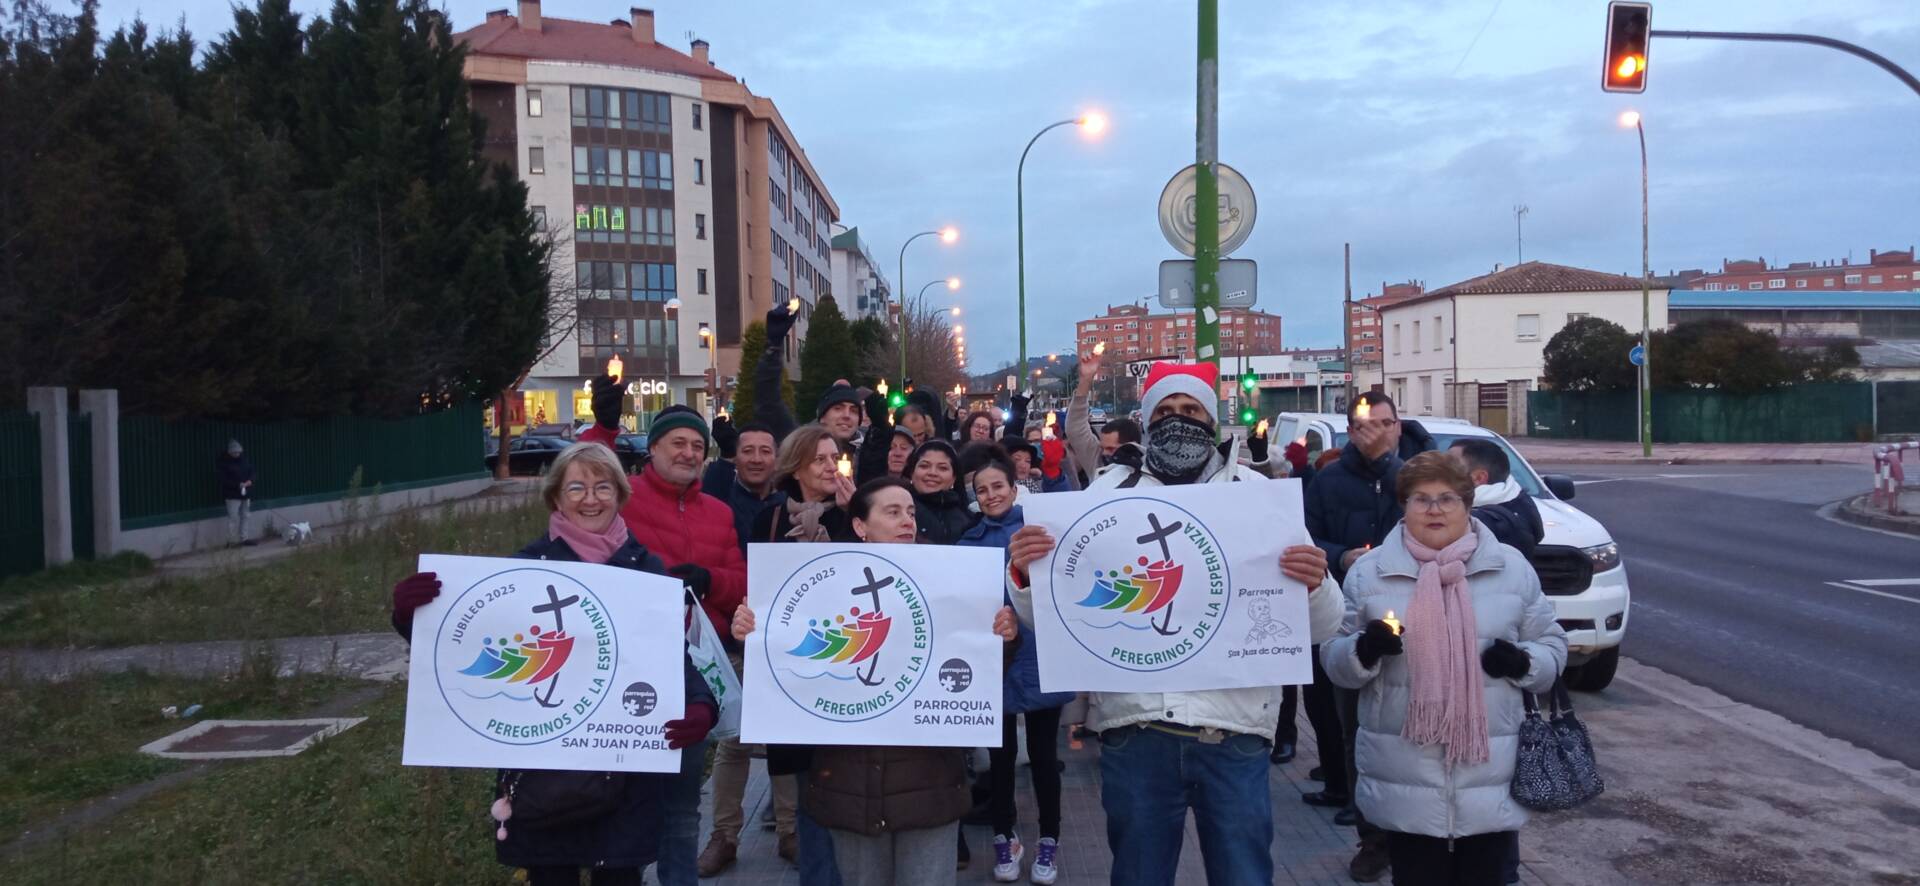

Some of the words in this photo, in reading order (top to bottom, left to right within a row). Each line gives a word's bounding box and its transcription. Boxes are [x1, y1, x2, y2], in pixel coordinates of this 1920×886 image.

[1065, 534, 1091, 578] JUBILEO
[1089, 515, 1118, 538] 2025
[1183, 522, 1223, 595] ESPERANZA
[781, 583, 810, 627] JUBILEO
[809, 567, 836, 586] 2025
[1238, 587, 1284, 598] Parroquia
[451, 599, 486, 645] JUBILEO
[485, 583, 516, 602] 2025
[894, 577, 927, 649] ESPERANZA
[1205, 602, 1221, 618] LA
[578, 596, 611, 671] ESPERANZA
[1192, 622, 1211, 640] DE
[1111, 638, 1194, 665] PEREGRINOS
[1258, 647, 1270, 655] de
[908, 656, 923, 673] LA
[588, 676, 606, 695] LA
[894, 674, 913, 693] DE
[573, 695, 593, 716] DE
[814, 690, 894, 716] PEREGRINOS
[914, 700, 991, 713] PARROQUIA
[486, 714, 572, 739] PEREGRINOS
[914, 714, 940, 726] SAN
[944, 712, 995, 726] ADRIÁN
[587, 723, 666, 736] PARROQUIA
[562, 737, 589, 748] SAN
[592, 738, 629, 749] JUAN
[632, 739, 669, 751] PABL
